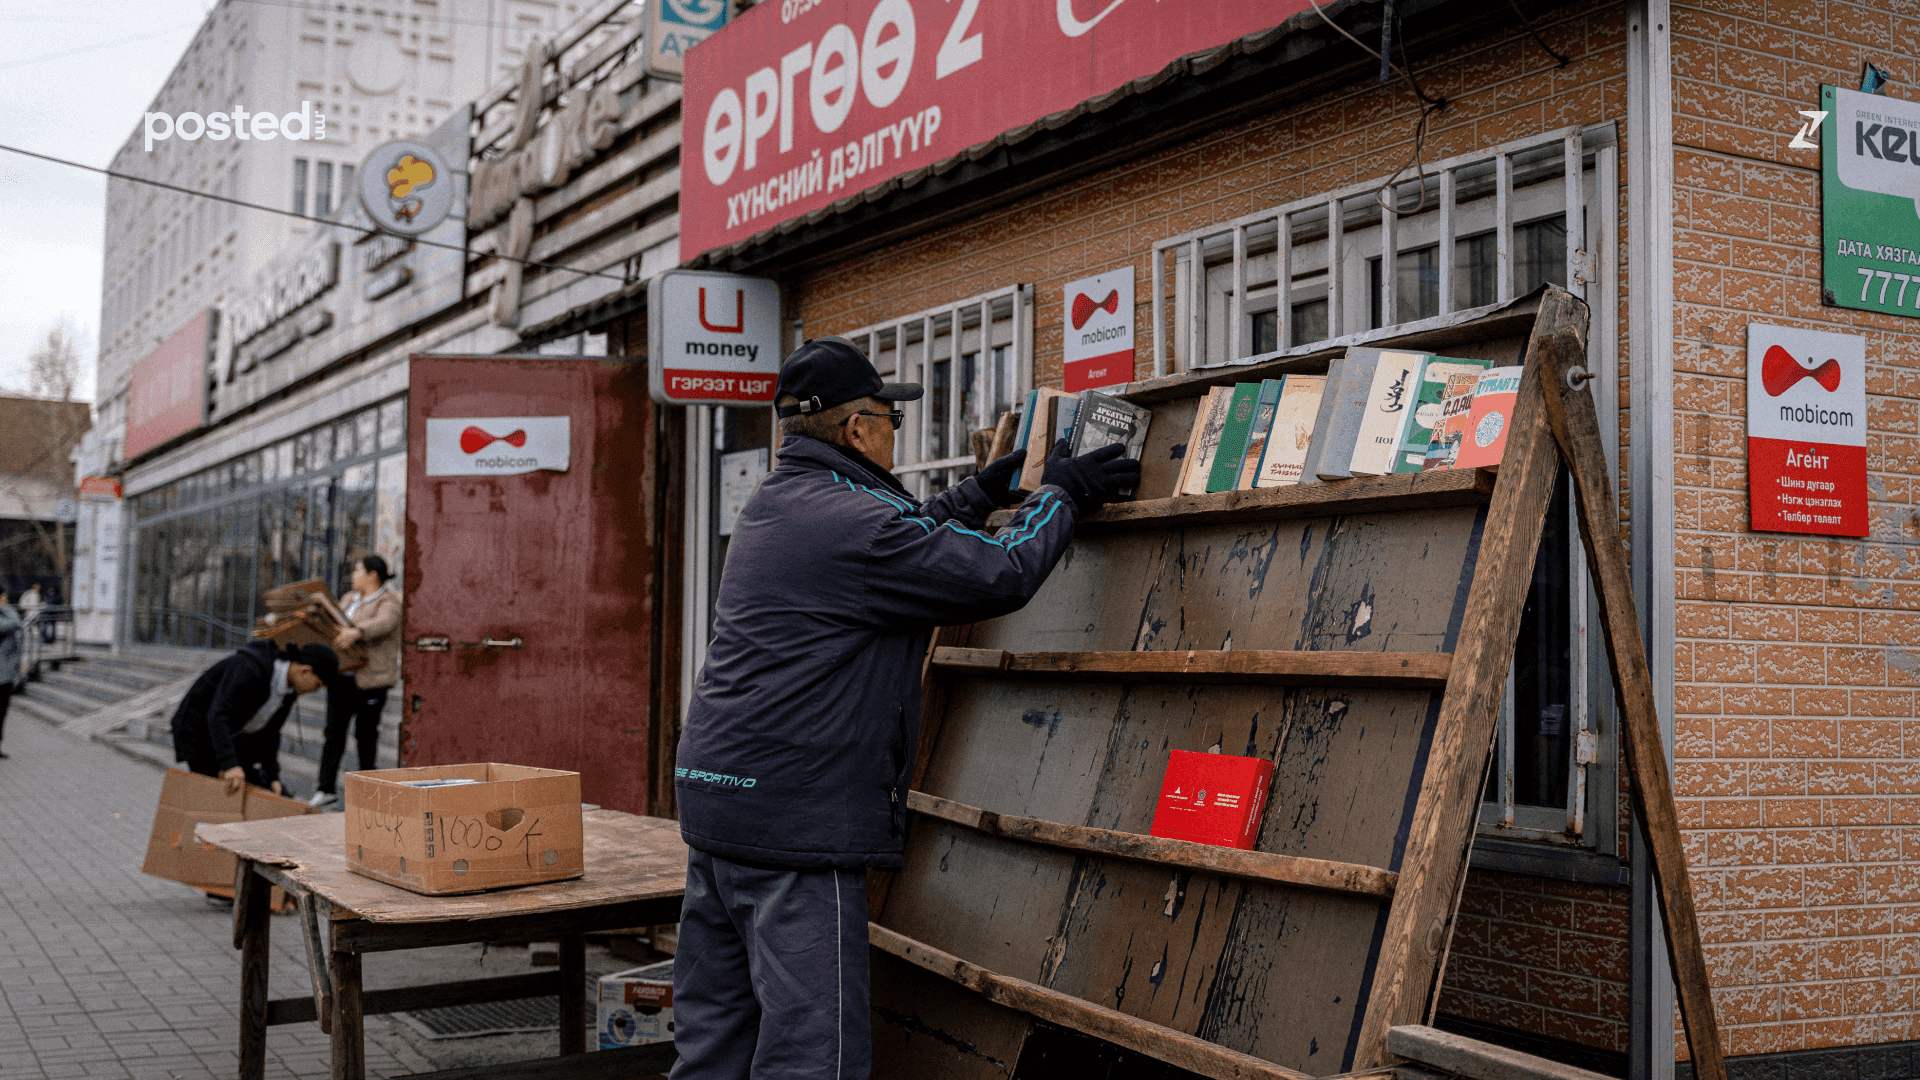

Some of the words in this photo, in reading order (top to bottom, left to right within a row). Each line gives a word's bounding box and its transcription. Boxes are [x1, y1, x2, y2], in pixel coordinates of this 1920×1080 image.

[703, 0, 916, 186] ӨРГӨӨ
[1856, 110, 1882, 122] GREEN
[726, 148, 823, 230] ХҮНСНИЙ
[827, 105, 942, 194] ДЭЛГҮҮР
[1837, 238, 1873, 259] ДАТА
[1875, 244, 1920, 266] ХЯЗГА
[1082, 325, 1126, 345] mobicom
[685, 341, 758, 362] money
[671, 376, 735, 392] ГЭРЭЭТ
[739, 379, 772, 395] ЦЭГ
[1780, 404, 1853, 428] mobicom
[475, 456, 538, 468] mobicom
[1786, 448, 1829, 469] Агент
[1781, 476, 1805, 488] Шинэ
[1806, 480, 1835, 493] дугаар
[689, 769, 757, 788] SPORTIVO
